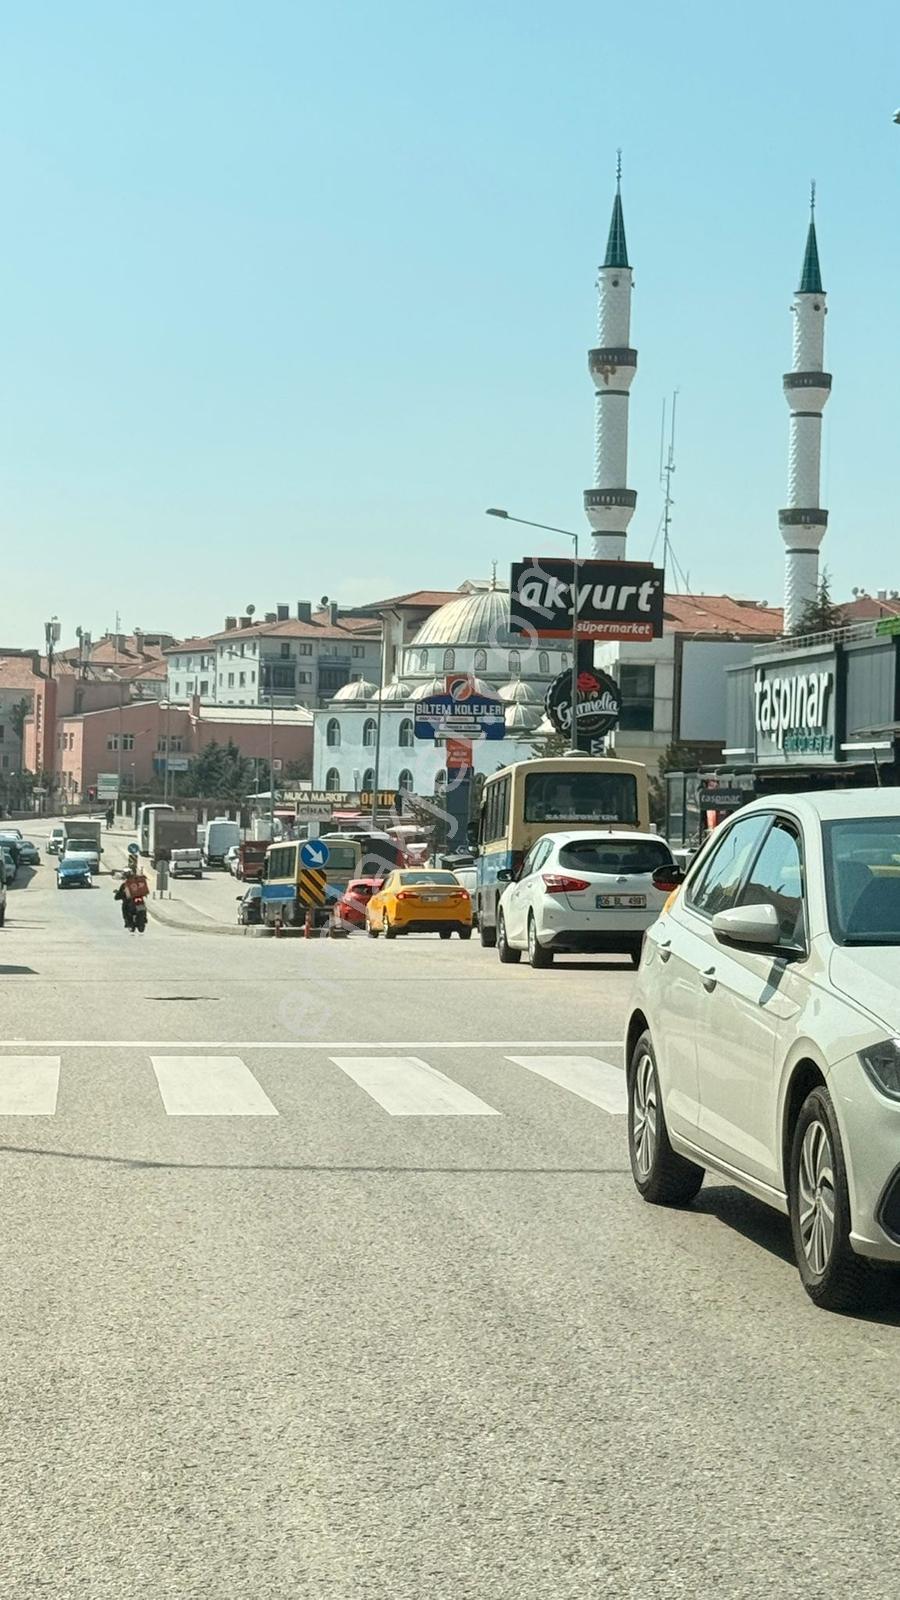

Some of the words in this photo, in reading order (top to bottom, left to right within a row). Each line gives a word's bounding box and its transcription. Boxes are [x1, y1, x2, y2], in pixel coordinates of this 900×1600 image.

[519, 576, 655, 616] akyurt
[577, 621, 651, 635] süpermarket
[416, 701, 452, 715] BİLTEM
[454, 702, 505, 716] KOLEJLERİ
[310, 791, 348, 803] MARKET
